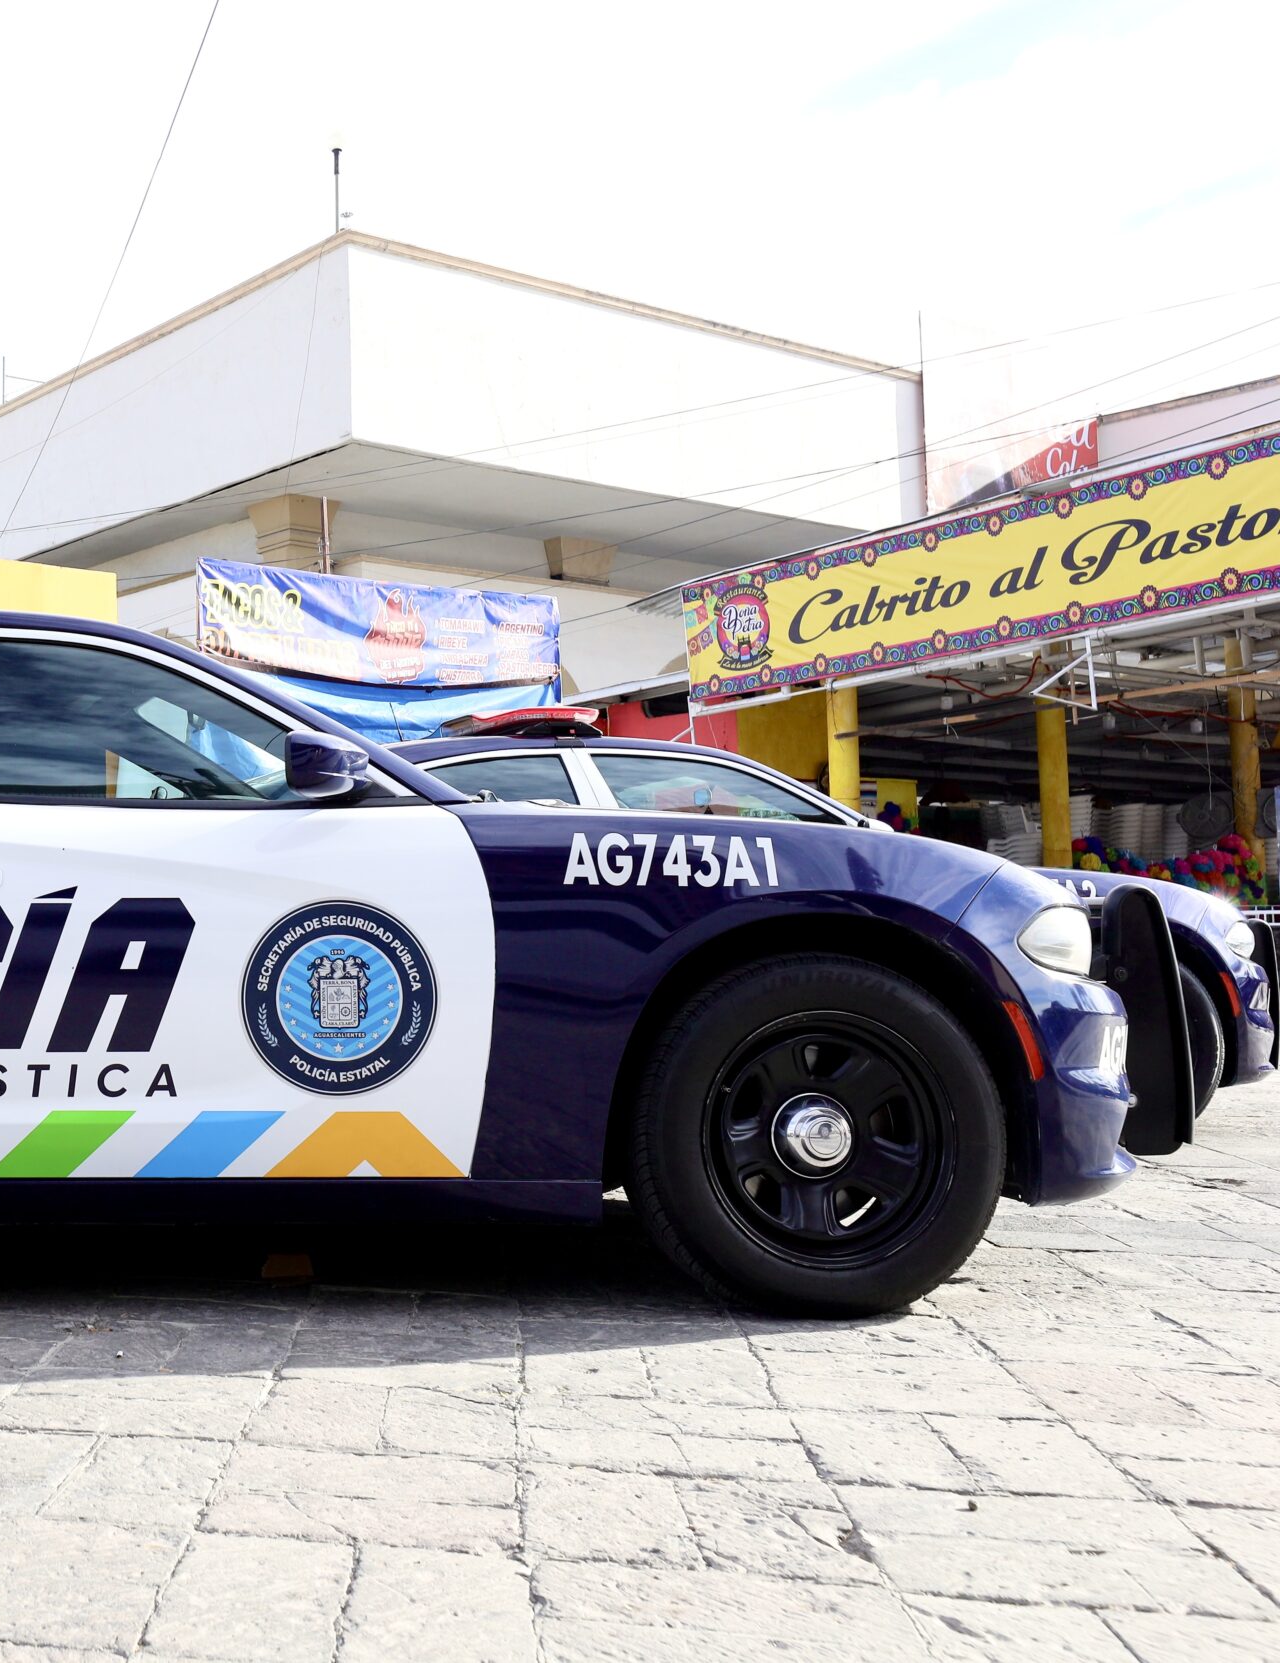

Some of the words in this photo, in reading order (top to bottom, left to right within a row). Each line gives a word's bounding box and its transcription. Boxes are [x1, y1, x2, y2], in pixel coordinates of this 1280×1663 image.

[788, 576, 971, 645] Cabrito
[989, 545, 1049, 598] al
[1060, 503, 1280, 586] Pasto
[202, 579, 281, 629] TACOS
[716, 586, 765, 609] Restaurante
[439, 636, 467, 648] RIBEYE
[499, 622, 544, 636] ARGENTINO
[563, 832, 779, 888] AG743A1
[257, 927, 305, 992] SECRETARÍA
[304, 918, 322, 933] DE
[321, 915, 394, 944] SEGURIDAD
[390, 939, 422, 992] PÚBLICA
[289, 1054, 338, 1083] POLICÍA
[339, 1056, 391, 1083] ESTATAL
